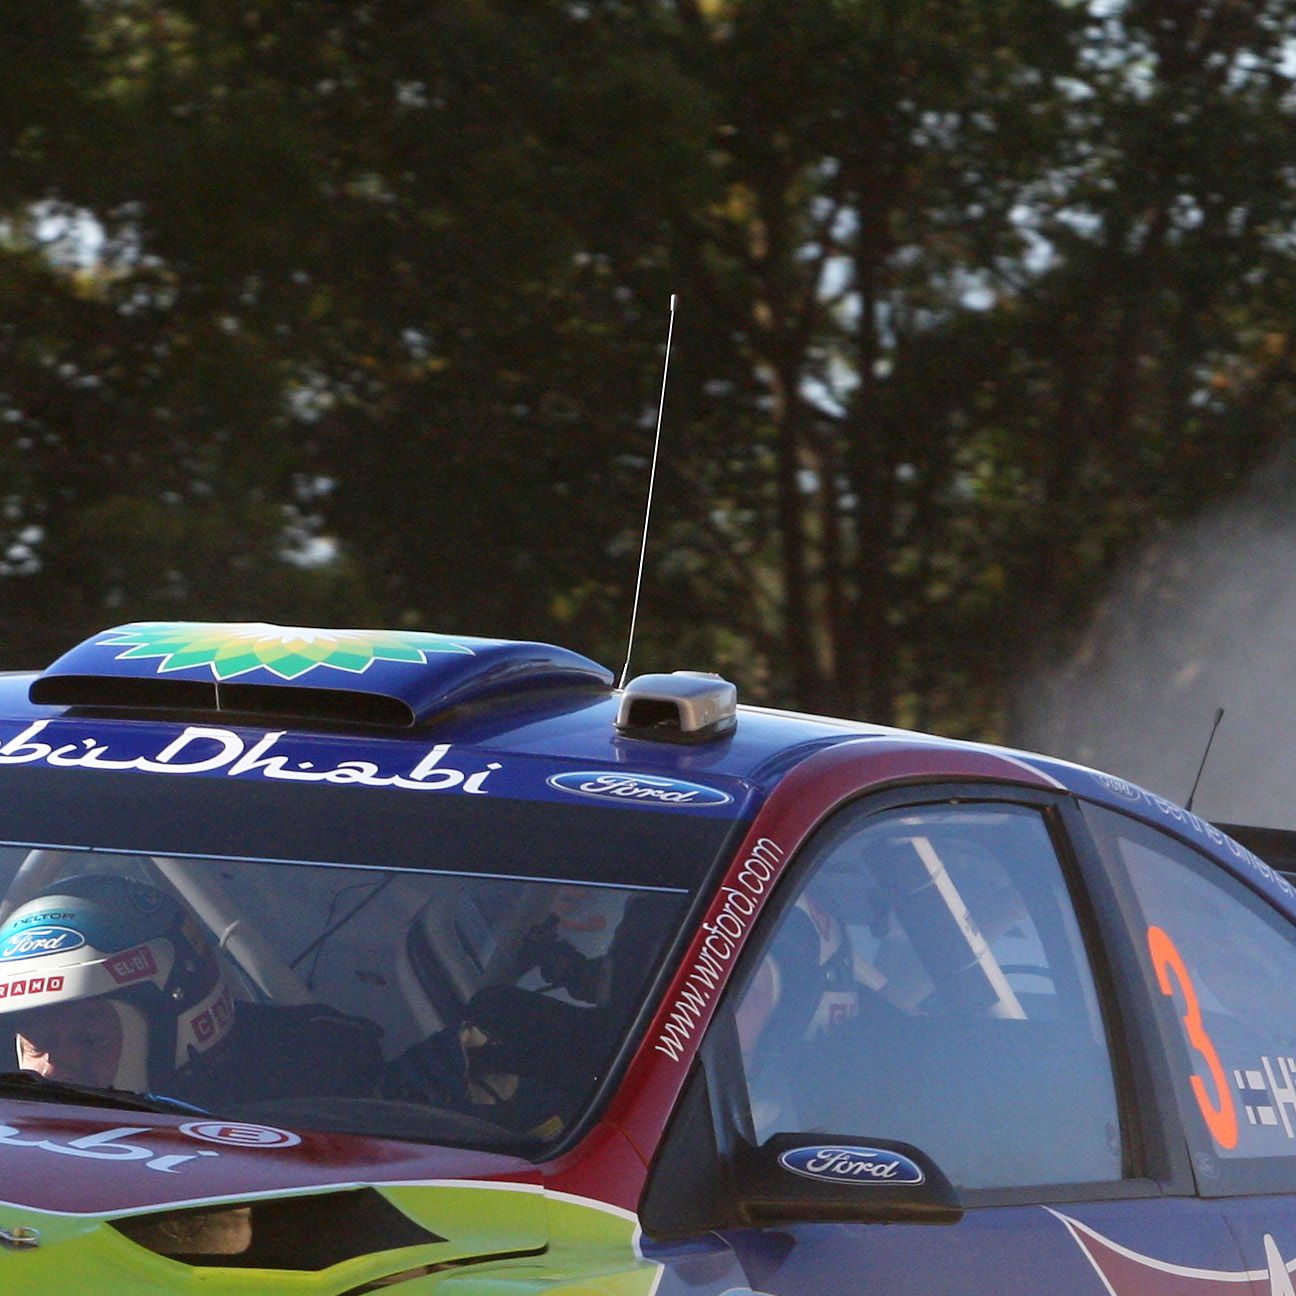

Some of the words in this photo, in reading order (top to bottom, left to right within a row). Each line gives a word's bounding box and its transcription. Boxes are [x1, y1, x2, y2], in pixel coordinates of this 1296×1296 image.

[150, 727, 502, 794] Dhabi
[580, 772, 700, 804] Ford
[5, 929, 66, 956] Ford
[655, 836, 784, 1063] www.wrcford.com
[1147, 926, 1239, 1150] 3
[807, 1145, 902, 1179] Ford
